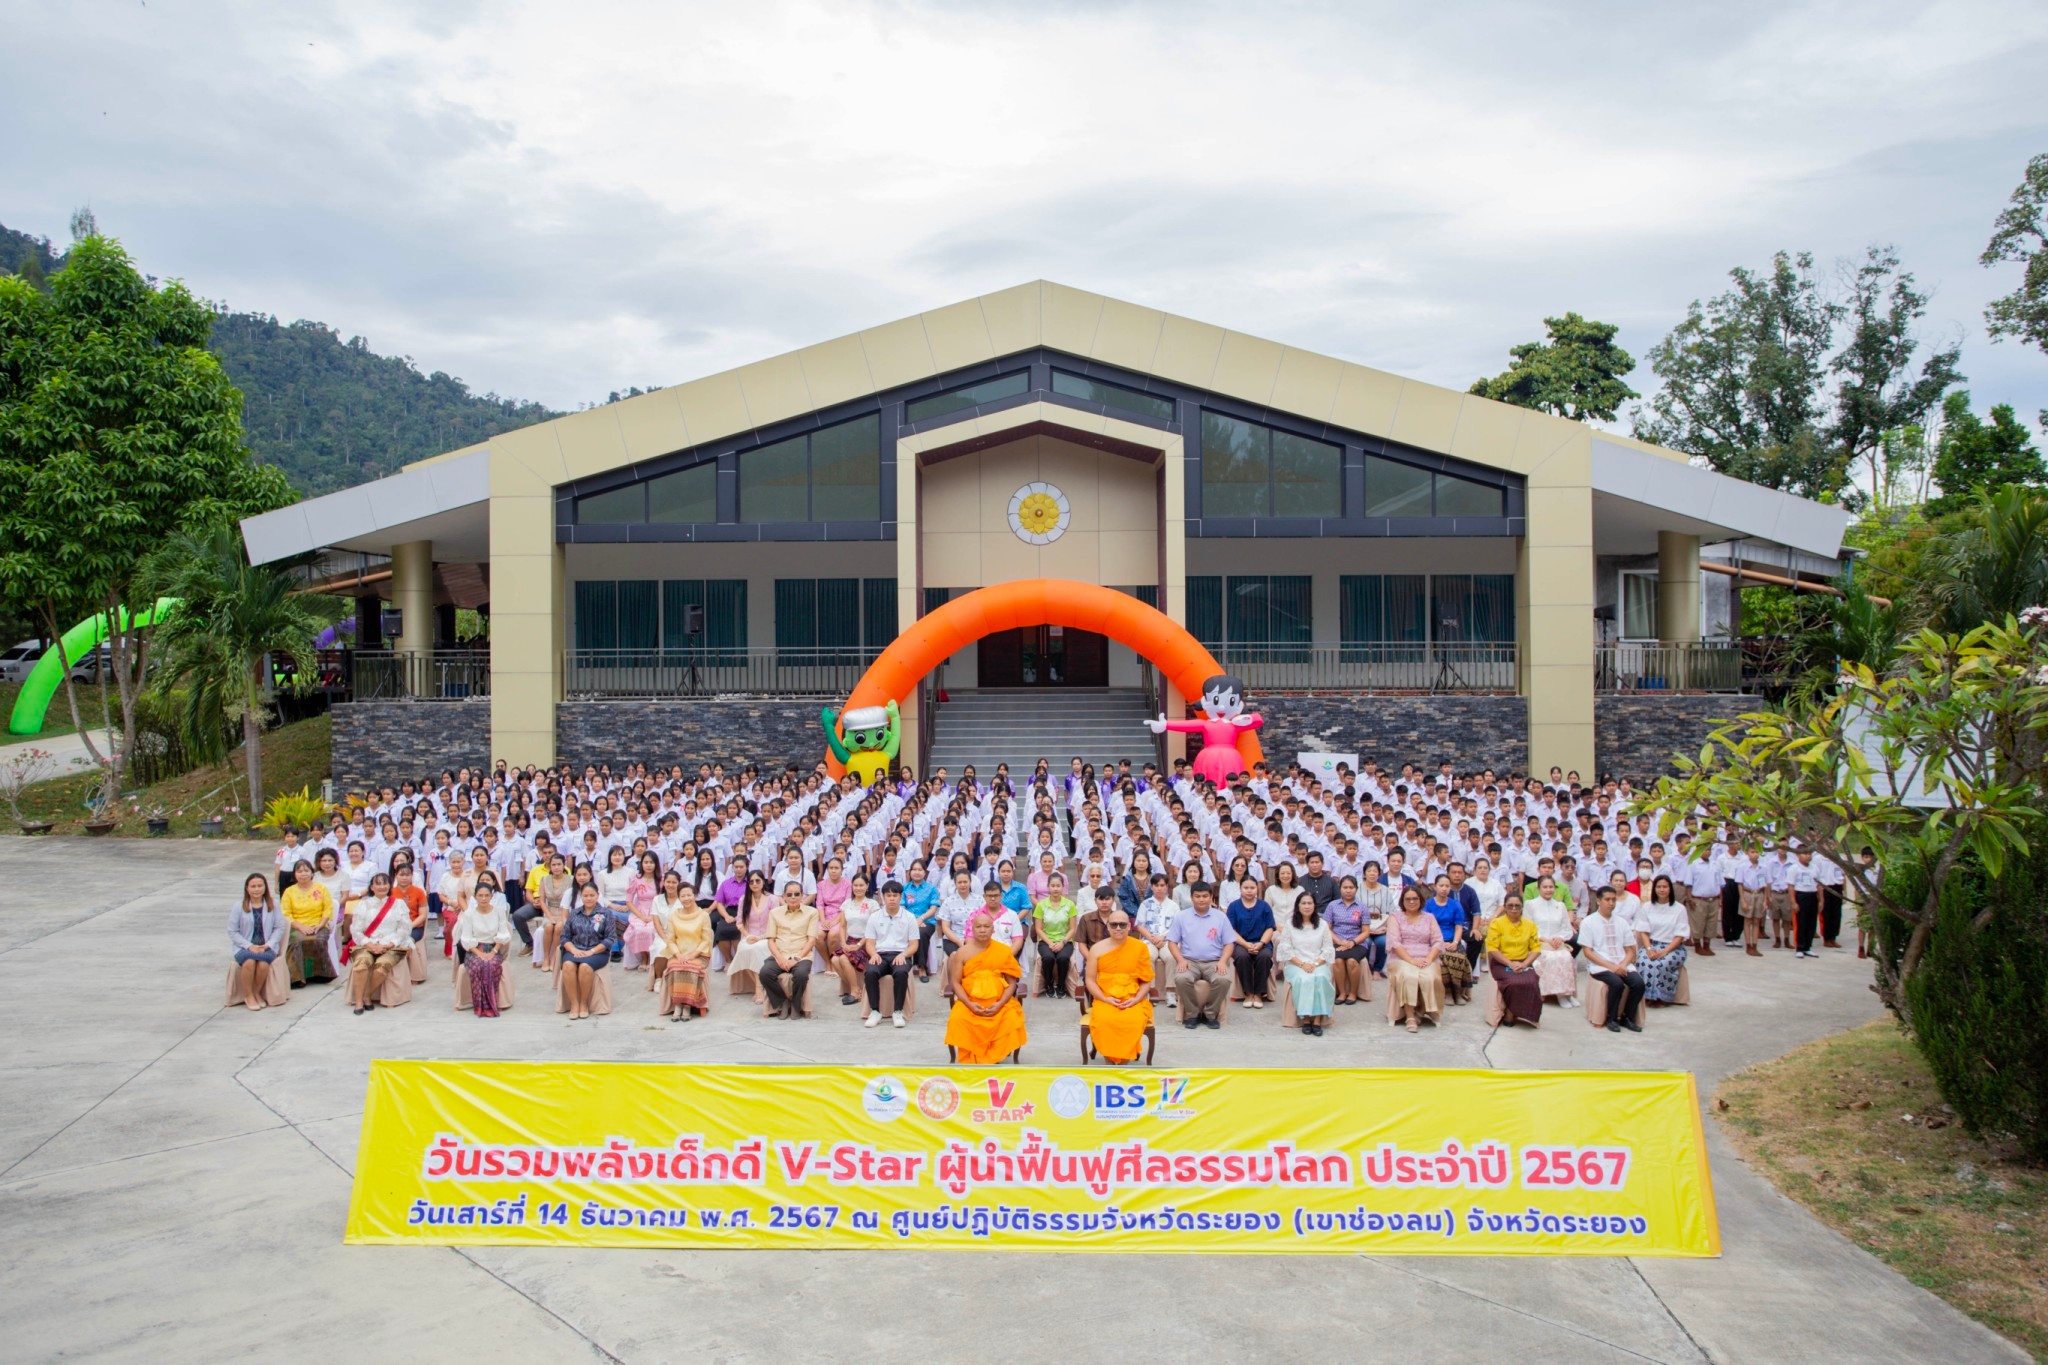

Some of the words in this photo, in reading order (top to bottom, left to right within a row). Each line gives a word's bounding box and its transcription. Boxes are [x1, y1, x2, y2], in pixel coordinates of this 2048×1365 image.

[988, 1078, 1014, 1108] V
[1095, 1085, 1145, 1108] IBS
[1160, 1077, 1188, 1104] 17
[972, 1108, 1025, 1123] STAR
[428, 1138, 762, 1180] วันรวมพลังเด็กดี
[782, 1146, 921, 1181] V-Star
[940, 1132, 1347, 1194] ผู้นำฟื้นฟูศีลธรรมโลก
[1367, 1143, 1507, 1185] ประจำปี
[1526, 1149, 1626, 1186] 2567
[409, 1194, 527, 1225] วันเสาร์ที่
[539, 1203, 568, 1226] 14
[581, 1202, 687, 1228] ธันวาคม
[700, 1208, 756, 1229] พ.ศ.
[769, 1206, 839, 1229] 2567
[852, 1211, 879, 1230] ณ
[892, 1204, 1280, 1238] ศูนย์ปฏิบัติธรรมจังหวัดระยอง
[1294, 1206, 1456, 1237] (เขาช่องลม)
[1467, 1207, 1647, 1235] จังหวัดระยอง
